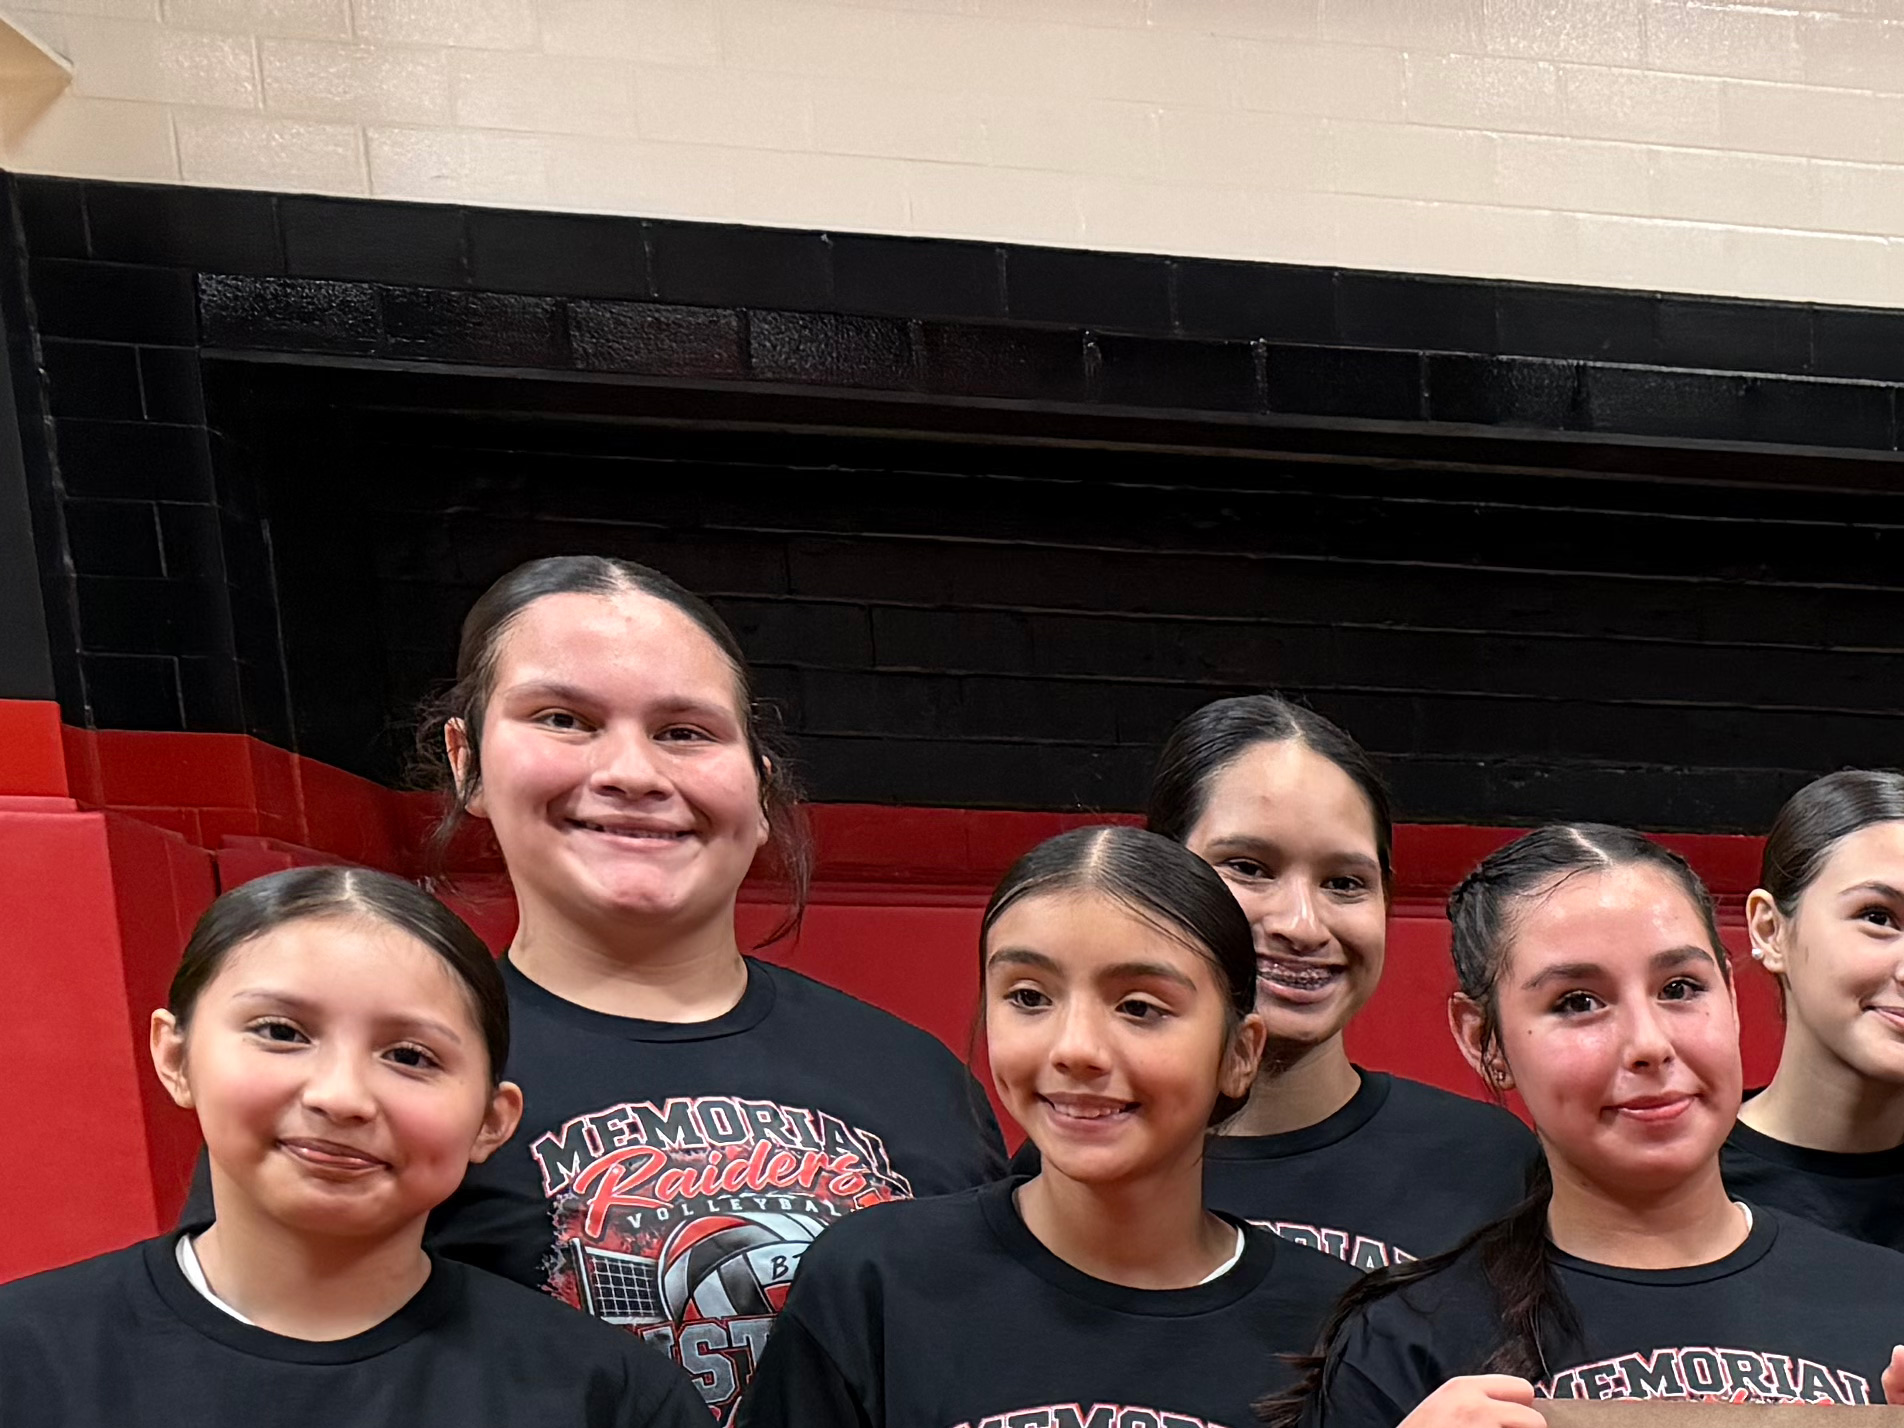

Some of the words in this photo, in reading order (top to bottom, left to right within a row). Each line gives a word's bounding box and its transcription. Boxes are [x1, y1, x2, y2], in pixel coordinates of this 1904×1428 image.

[530, 1096, 915, 1198] MEMORIAL
[573, 1139, 868, 1239] Raiders
[627, 1197, 855, 1231] VOLLEYBAL
